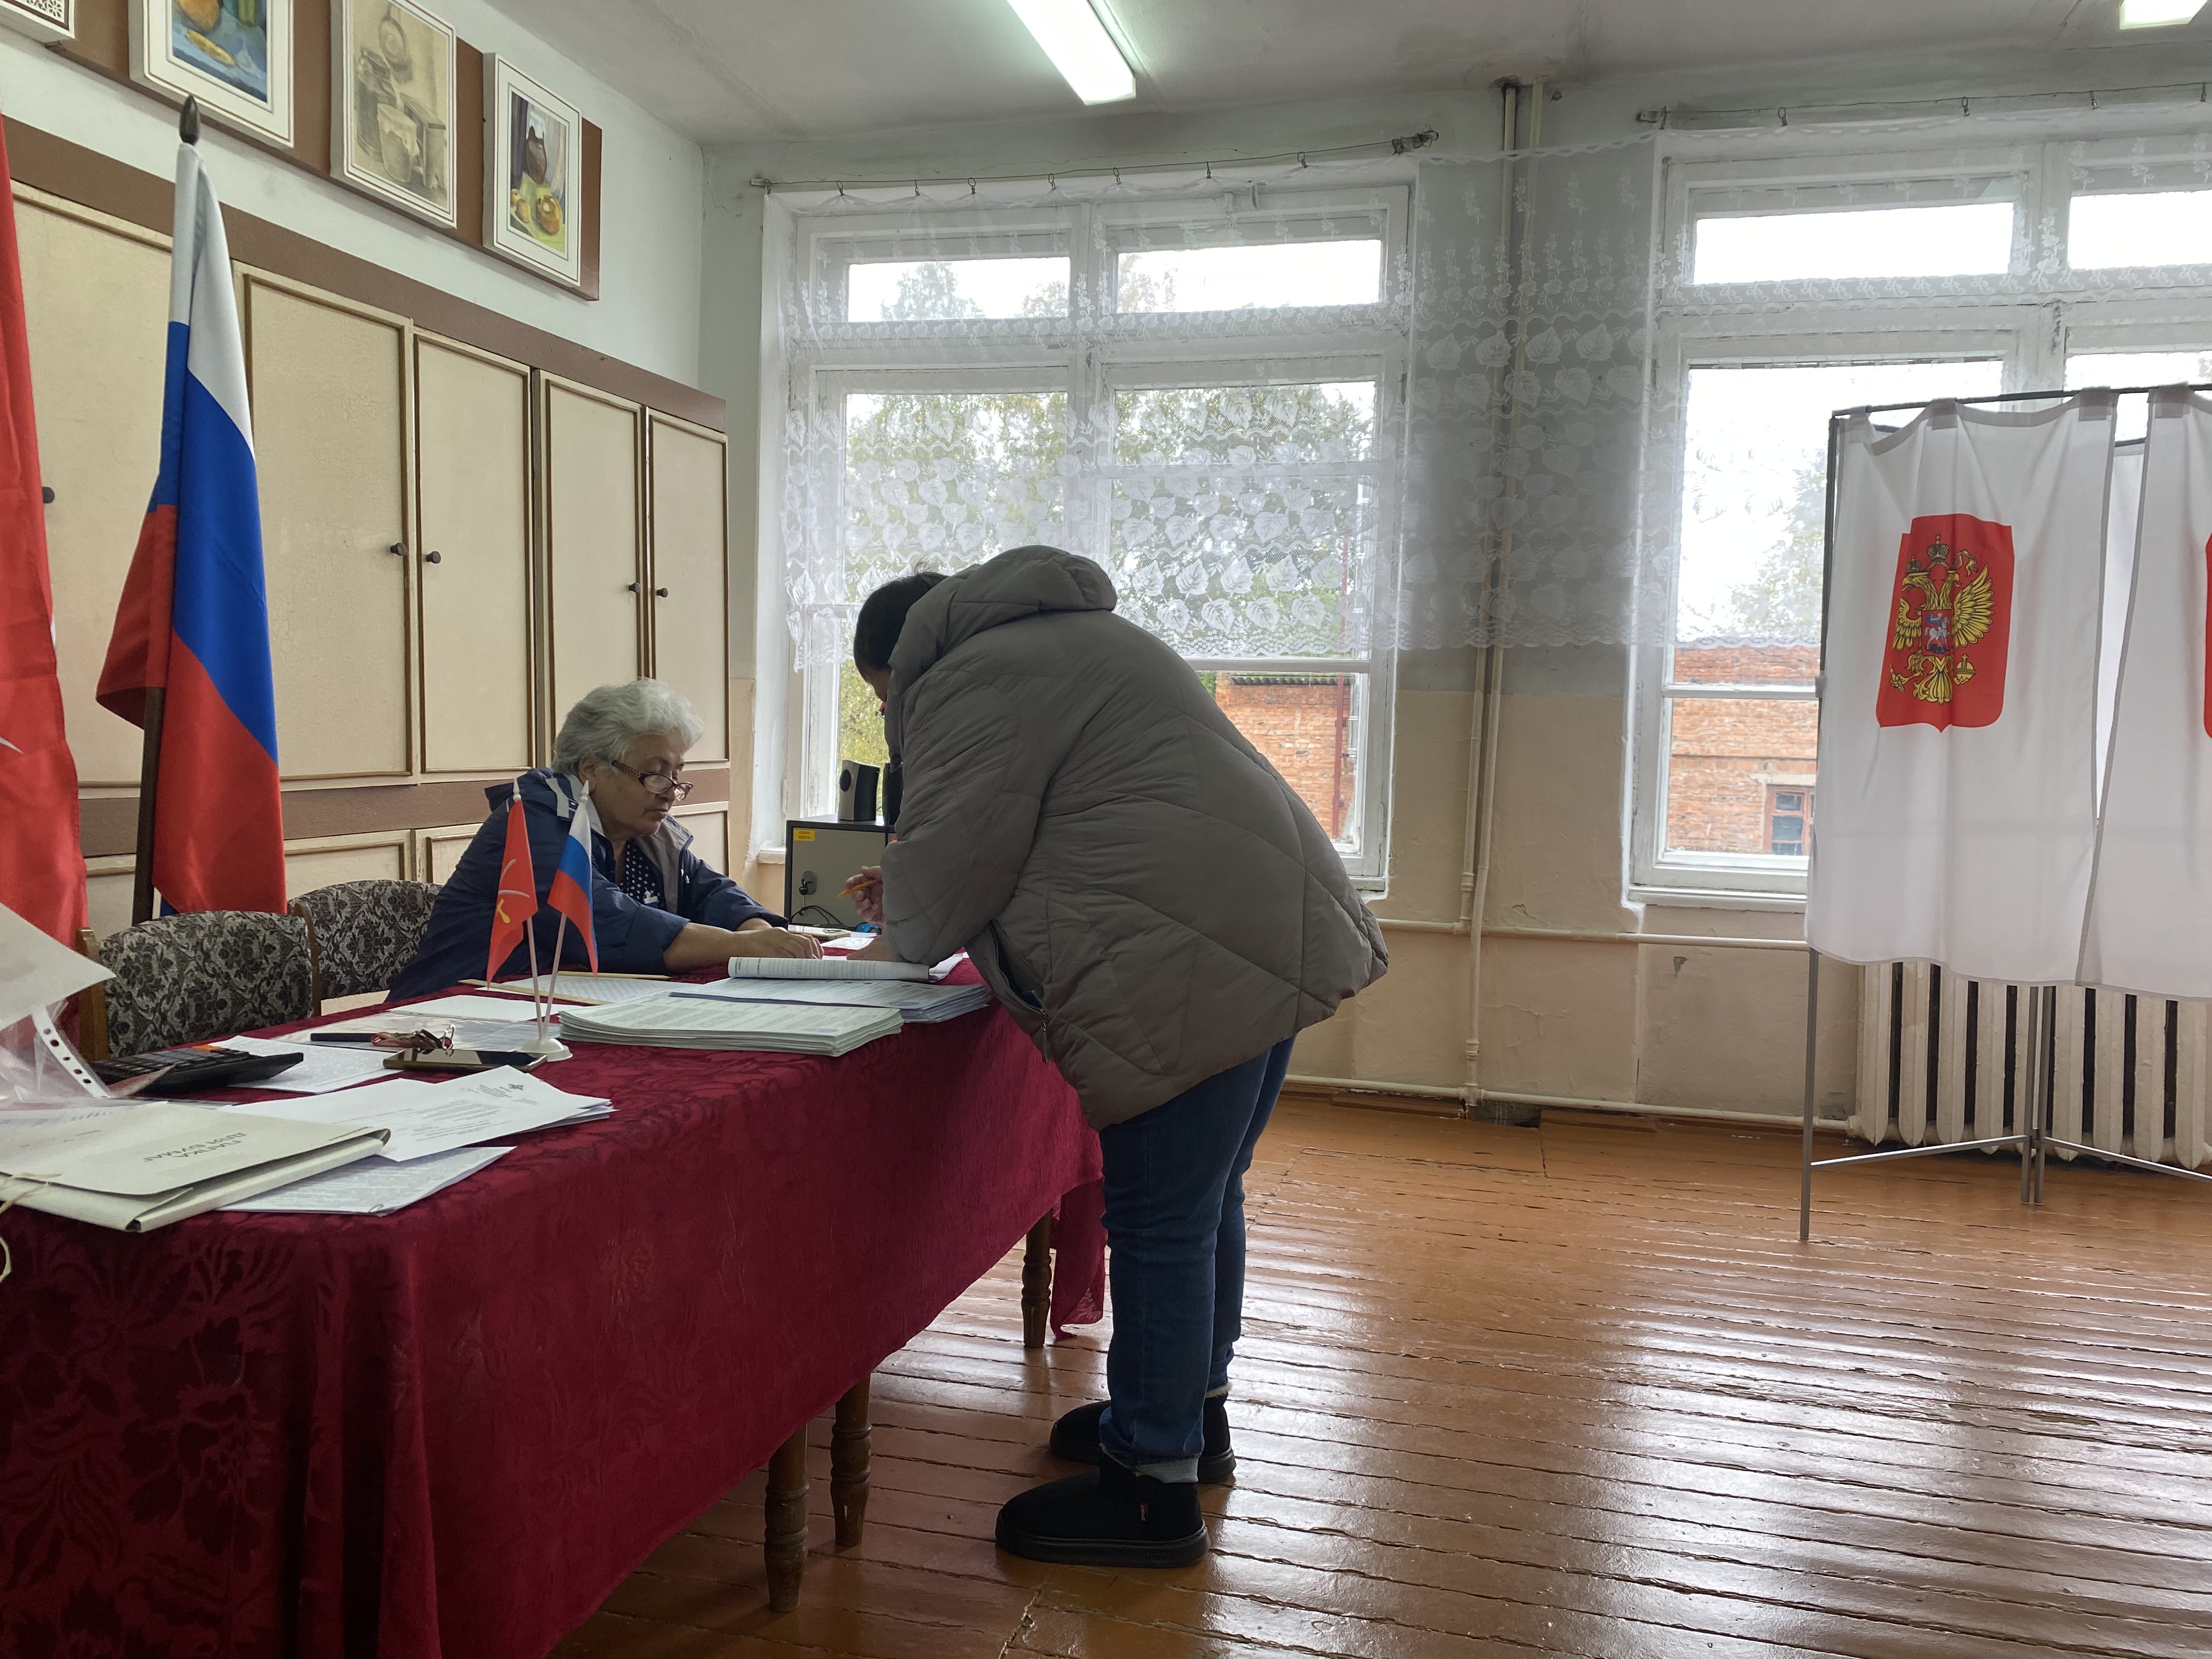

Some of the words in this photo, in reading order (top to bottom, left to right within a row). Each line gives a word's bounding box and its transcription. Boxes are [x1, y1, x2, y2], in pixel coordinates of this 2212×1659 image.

[205, 1132, 247, 1144] ДЛЯ
[143, 1144, 205, 1163] БУМАГ
[172, 1140, 242, 1158] ПАПКА
